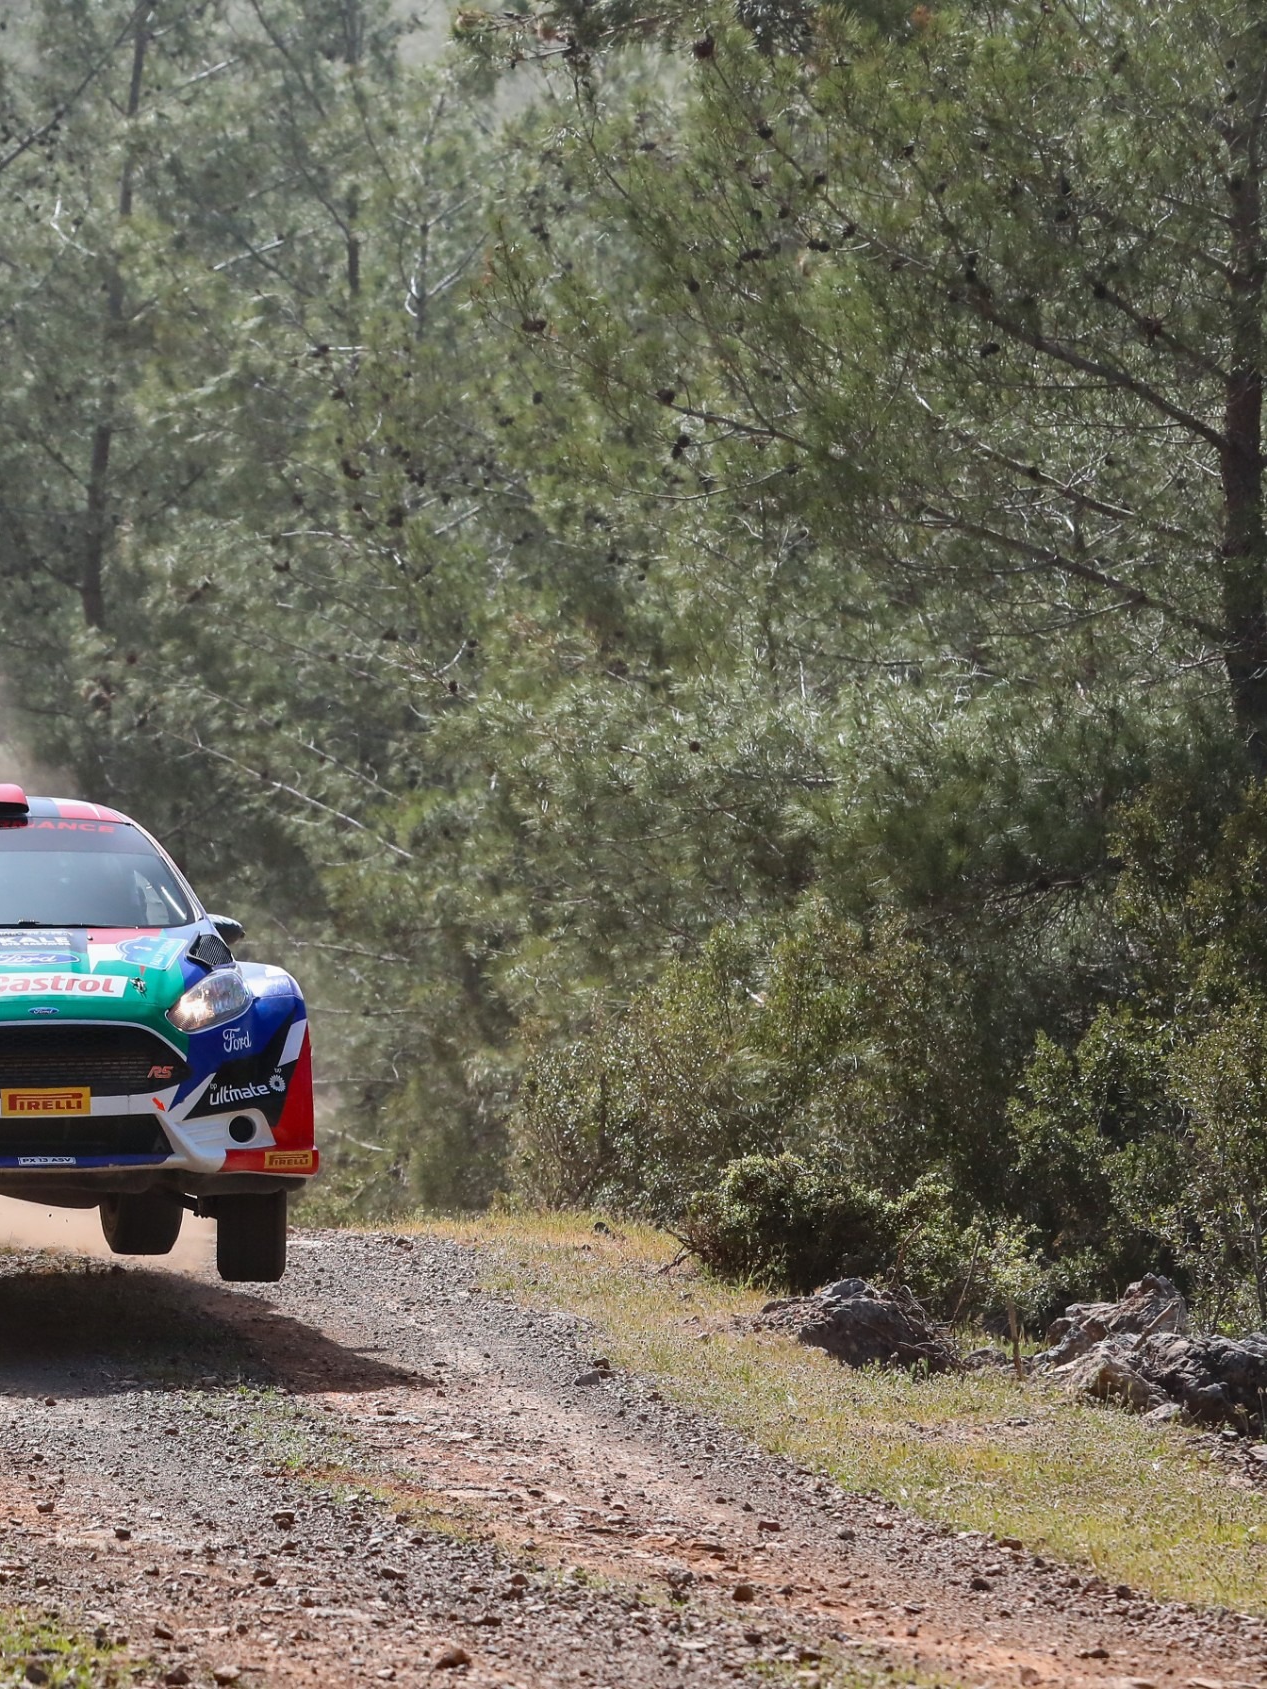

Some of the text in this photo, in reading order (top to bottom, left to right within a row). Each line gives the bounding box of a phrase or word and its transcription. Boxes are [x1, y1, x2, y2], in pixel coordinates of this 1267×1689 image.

[222, 1027, 252, 1053] Ford
[147, 1065, 174, 1079] RS
[7, 1092, 84, 1111] PIRELLI
[209, 1082, 271, 1105] ultimate
[268, 1153, 309, 1166] PIRELLI
